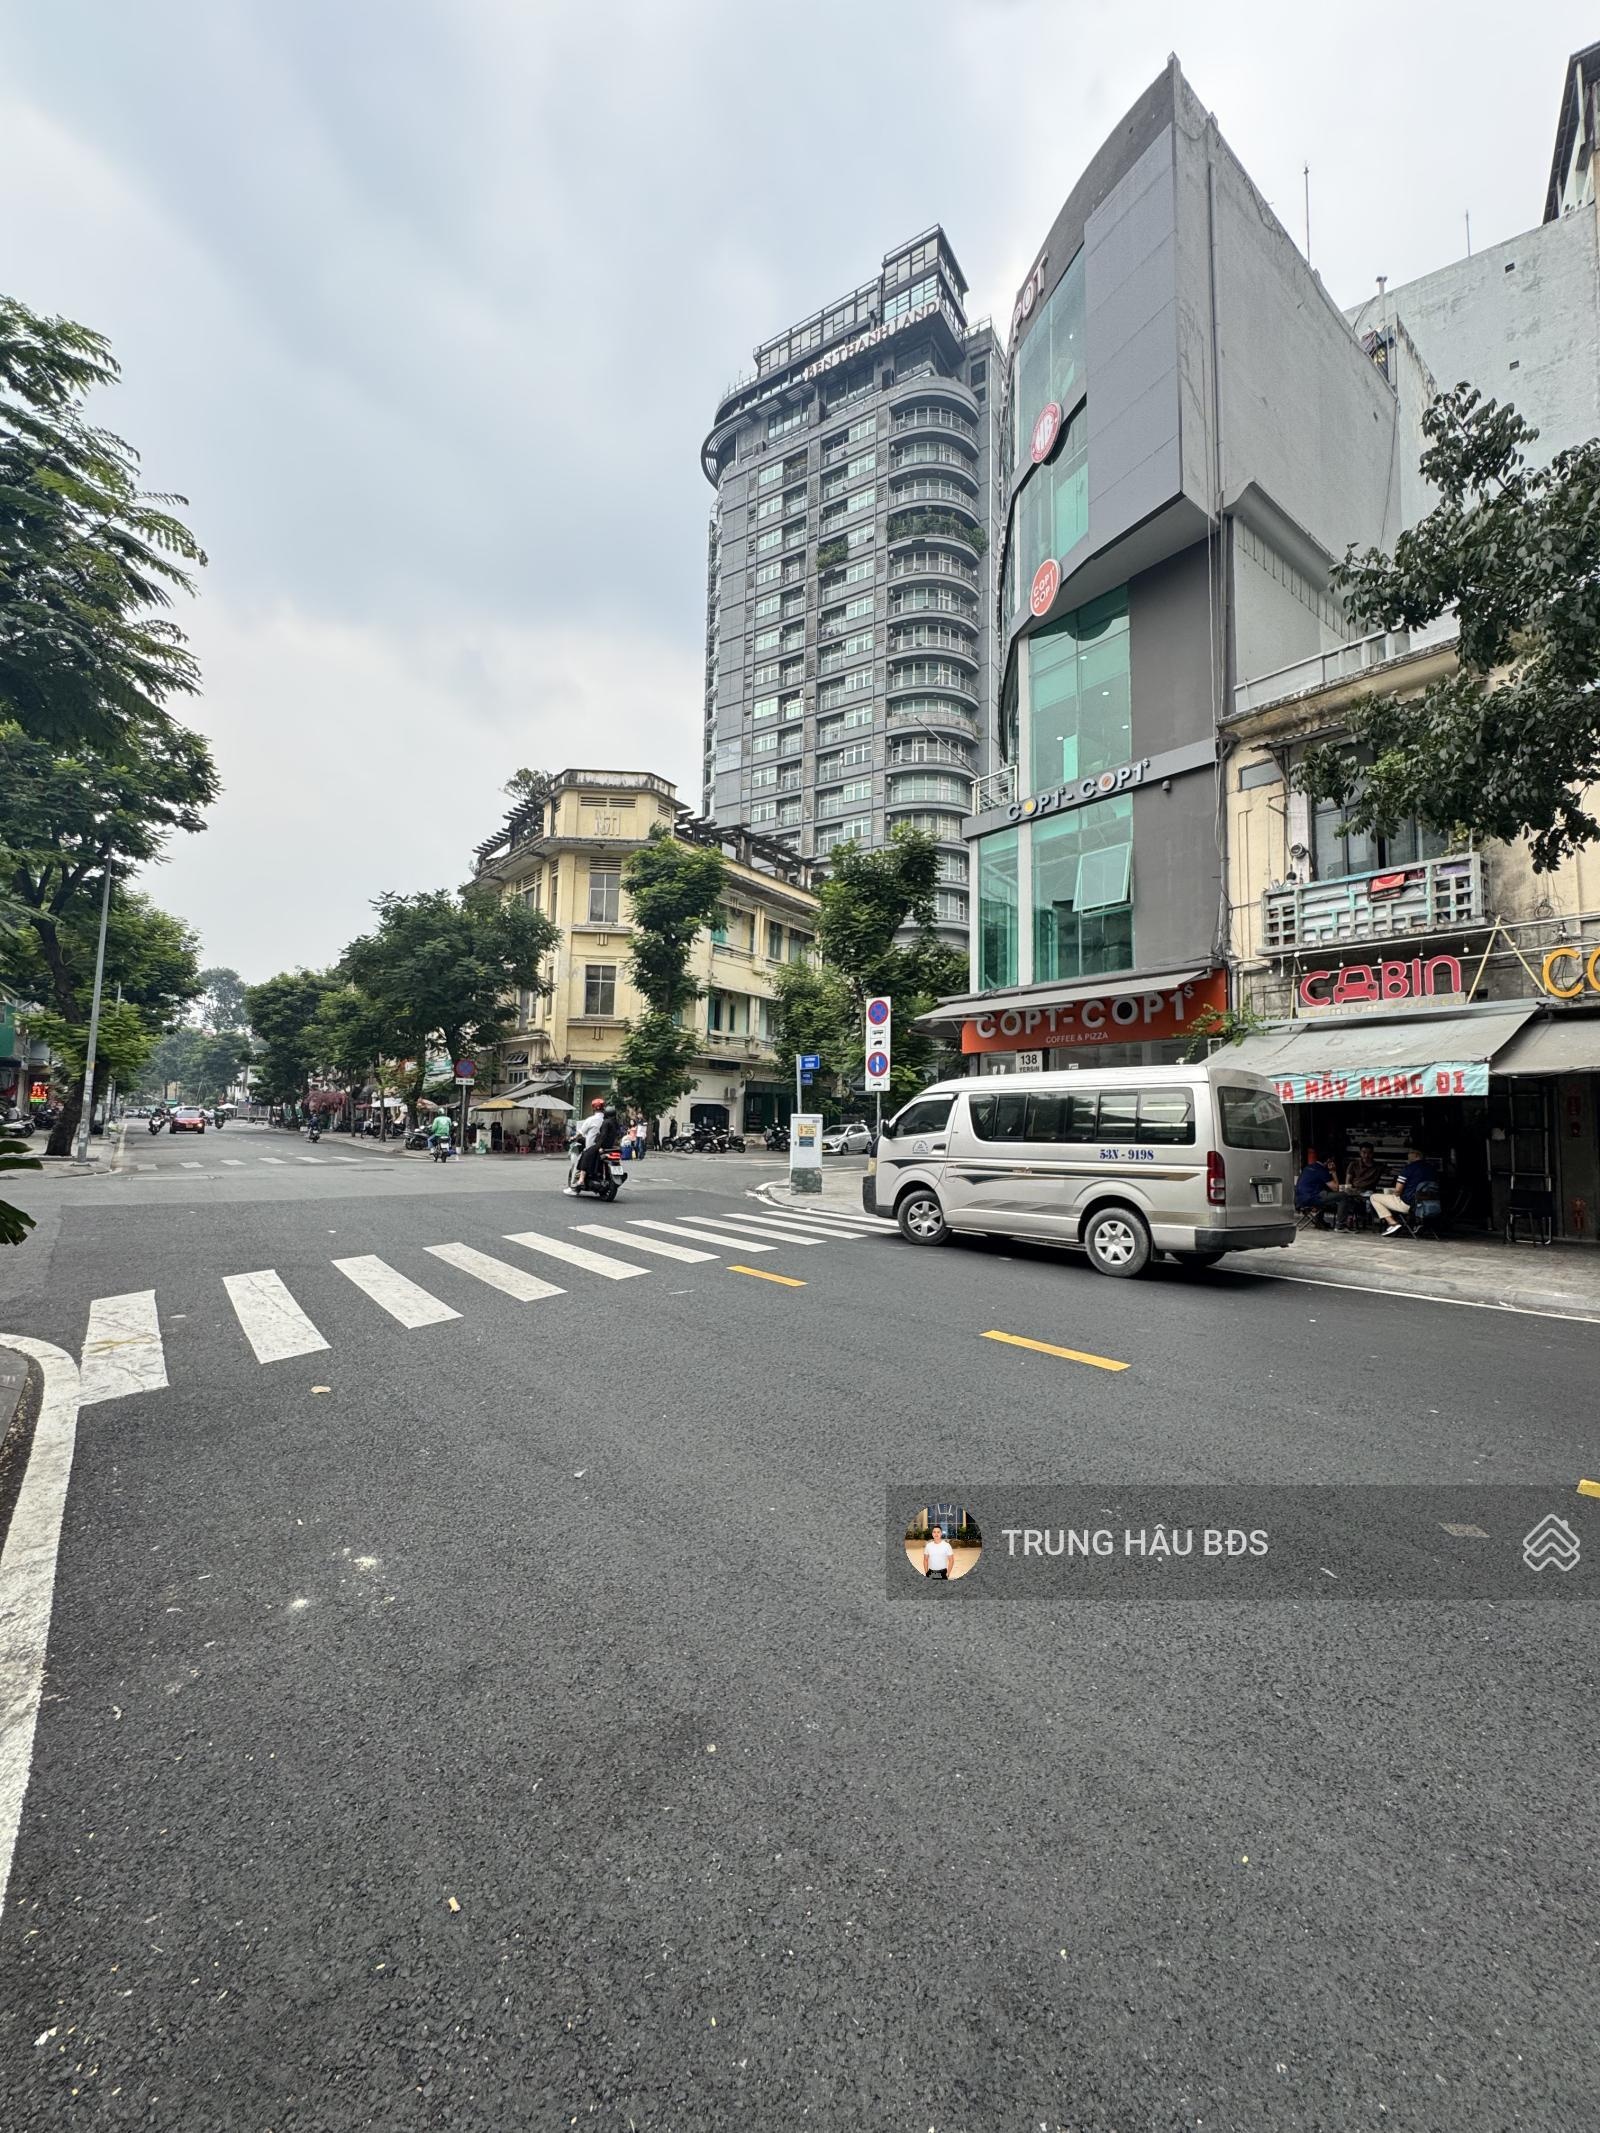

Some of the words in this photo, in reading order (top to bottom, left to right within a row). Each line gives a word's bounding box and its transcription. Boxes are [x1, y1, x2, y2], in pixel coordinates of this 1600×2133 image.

[805, 355, 834, 379] BEN
[834, 324, 891, 361] THANH
[892, 301, 939, 333] LAND
[1045, 1034, 1076, 1044] COFFEE
[1077, 1033, 1083, 1042] &
[1084, 1032, 1109, 1042] PIZZA
[1020, 1054, 1038, 1065] 138
[1360, 1073, 1424, 1098] MANG
